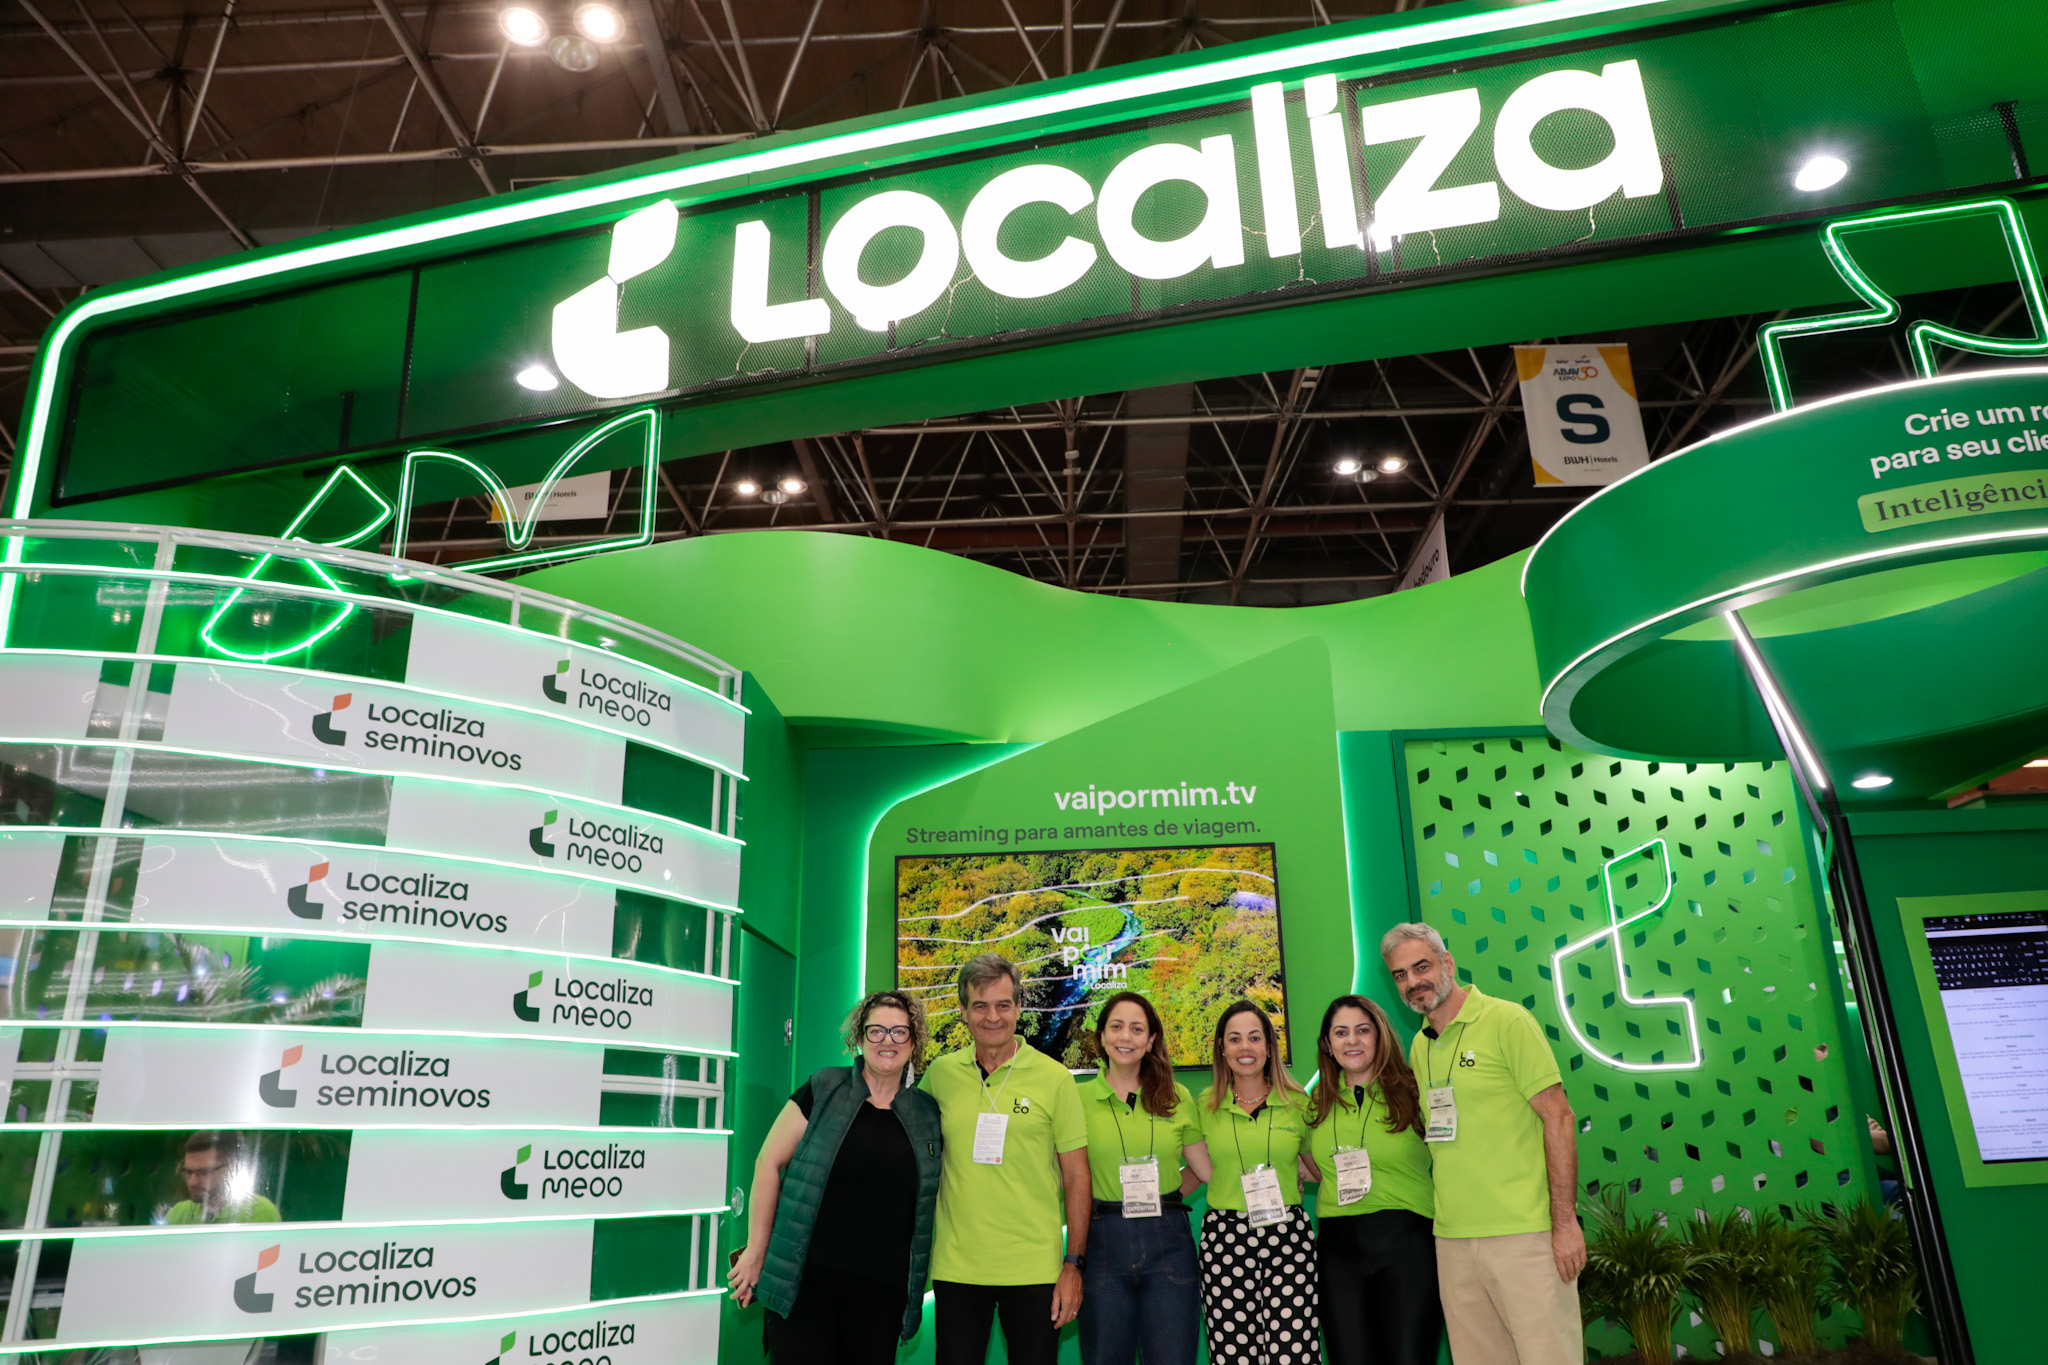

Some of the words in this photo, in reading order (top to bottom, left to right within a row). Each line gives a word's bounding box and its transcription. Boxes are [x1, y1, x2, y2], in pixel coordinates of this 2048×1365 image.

[730, 58, 1666, 343] Localiza
[1556, 394, 1610, 444] S
[1905, 408, 1970, 435] Crie
[1976, 407, 2025, 425] um
[1564, 456, 1589, 465] BWH
[1870, 447, 1940, 479] para
[1946, 438, 2001, 460] seu
[553, 490, 577, 498] Hotels
[581, 668, 671, 712] Localiza
[368, 703, 485, 738] Localiza
[579, 692, 651, 726] meoo
[364, 730, 522, 771] seminovos
[1053, 781, 1257, 816] vaipormim.tv
[569, 817, 663, 854] Localiza
[906, 825, 1009, 845] Streaming
[1015, 826, 1058, 845] para
[1063, 822, 1148, 839] amantes
[1153, 819, 1178, 836] de
[1183, 819, 1261, 838] viagem.
[567, 842, 642, 873] meoo
[346, 872, 468, 901] Localiza
[342, 900, 508, 933] seminovos
[1051, 927, 1089, 943] vai
[1072, 963, 1127, 980] mim
[1090, 981, 1127, 990] Localiza
[555, 977, 653, 1007] Localiza
[553, 1004, 632, 1029] meoo
[321, 1050, 450, 1077] Localiza
[1459, 1059, 1475, 1067] CO
[316, 1080, 491, 1108] seminovos
[1013, 1106, 1029, 1114] CO
[544, 1143, 645, 1170] Localiza
[542, 1177, 622, 1199] meoo
[299, 1242, 434, 1274] Localiza
[294, 1275, 476, 1308] seminovos
[529, 1320, 635, 1356] Localiza
